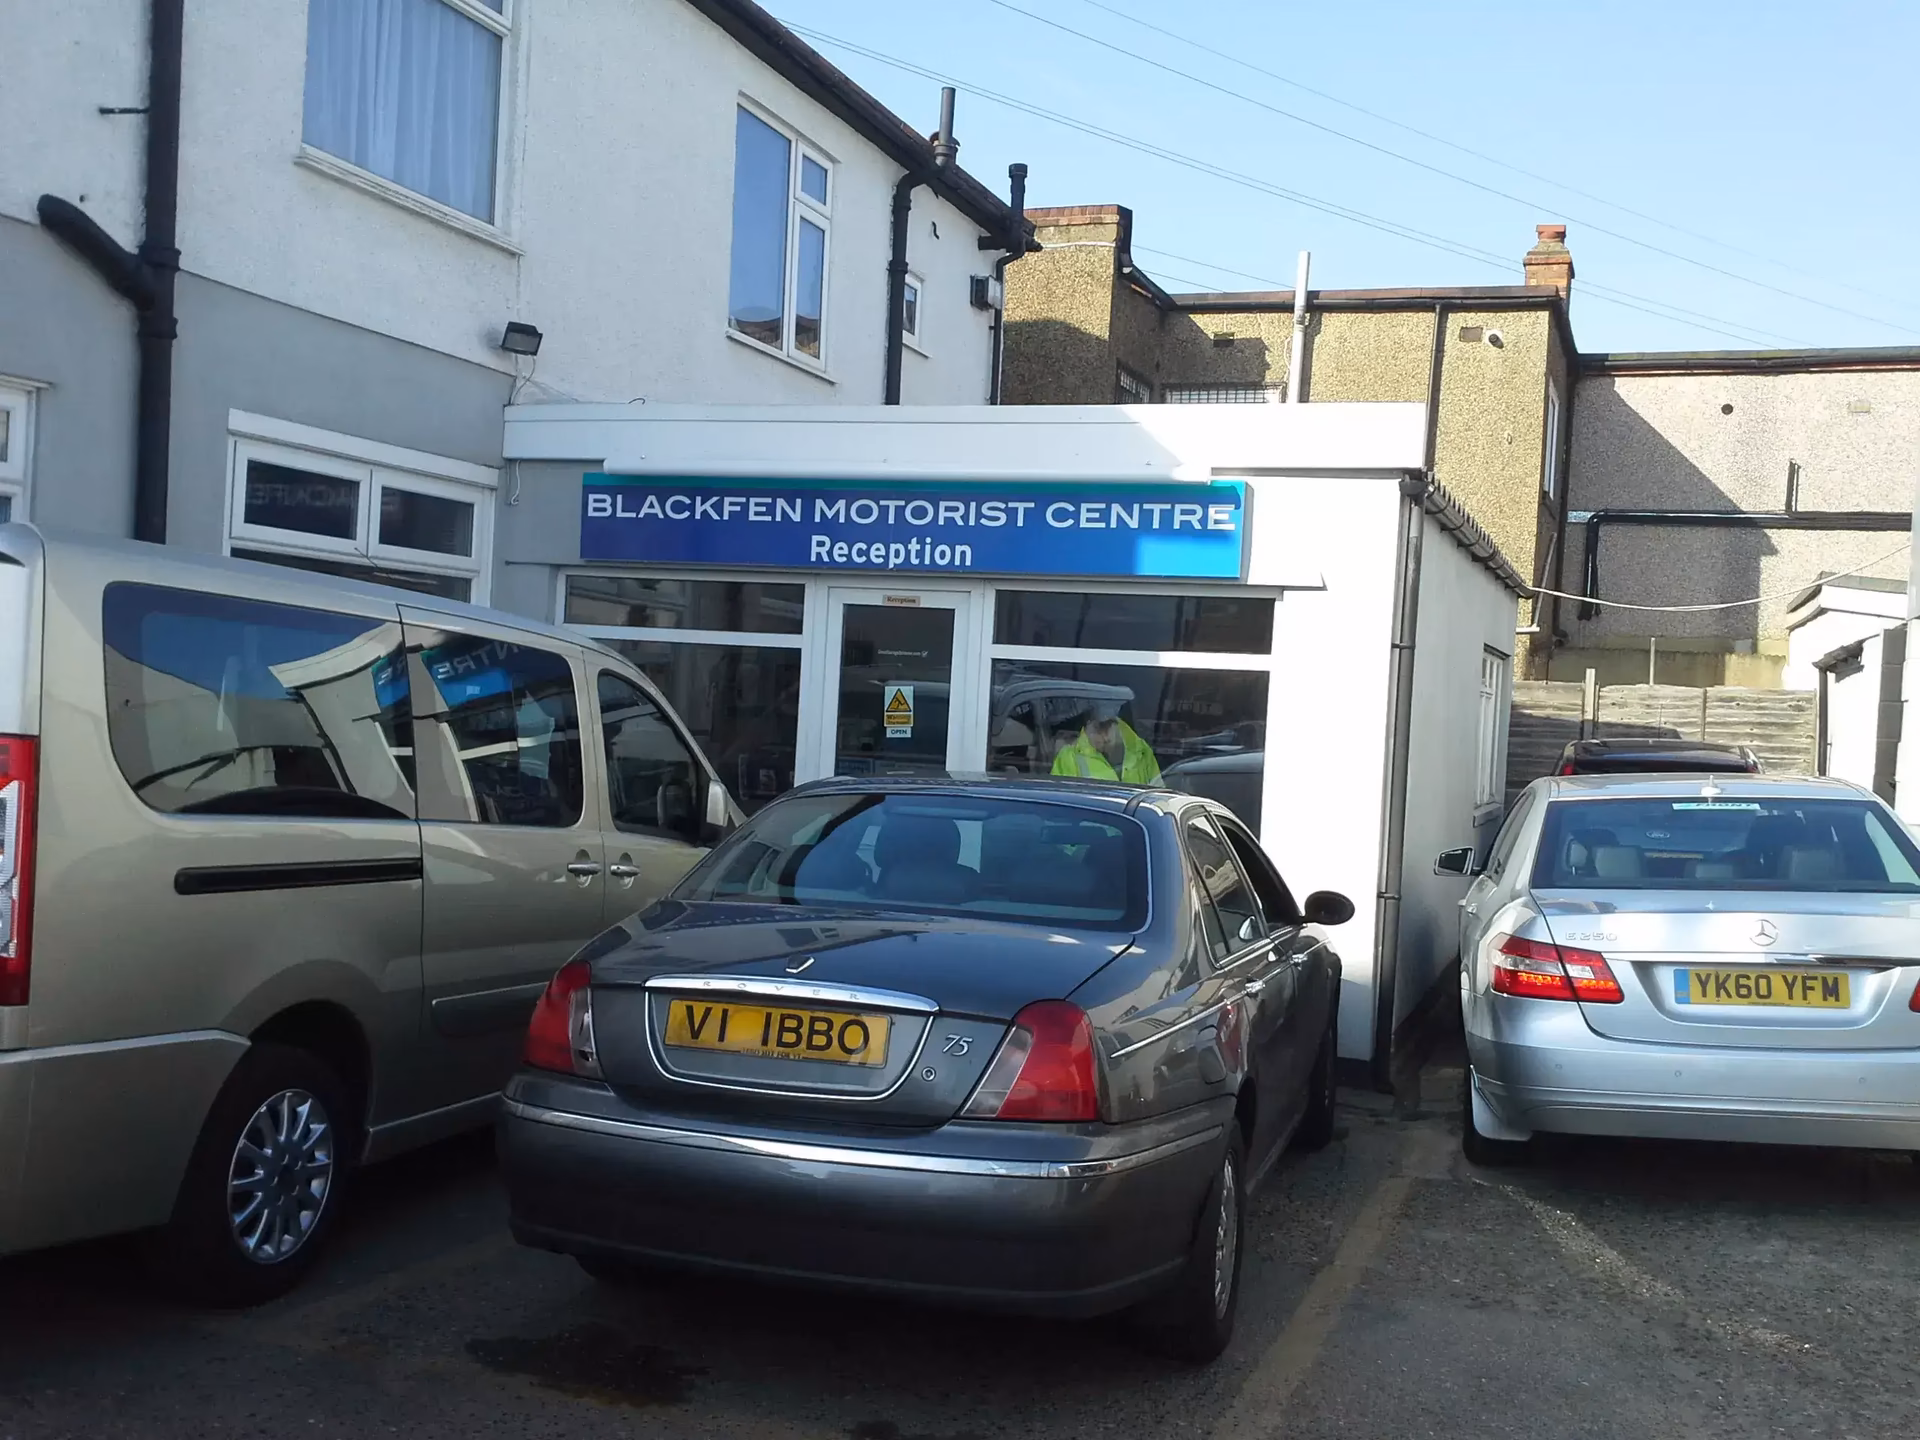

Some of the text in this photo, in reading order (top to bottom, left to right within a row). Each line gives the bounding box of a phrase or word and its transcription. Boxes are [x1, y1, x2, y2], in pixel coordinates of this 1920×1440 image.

[587, 493, 1236, 531] BLACKFEN MOTORIST CENTRE
[810, 535, 973, 569] Reception
[1565, 931, 1577, 941] E
[702, 979, 860, 1001] ROVER
[1694, 971, 1841, 1003] YK60 YFM
[944, 1032, 974, 1057] 75
